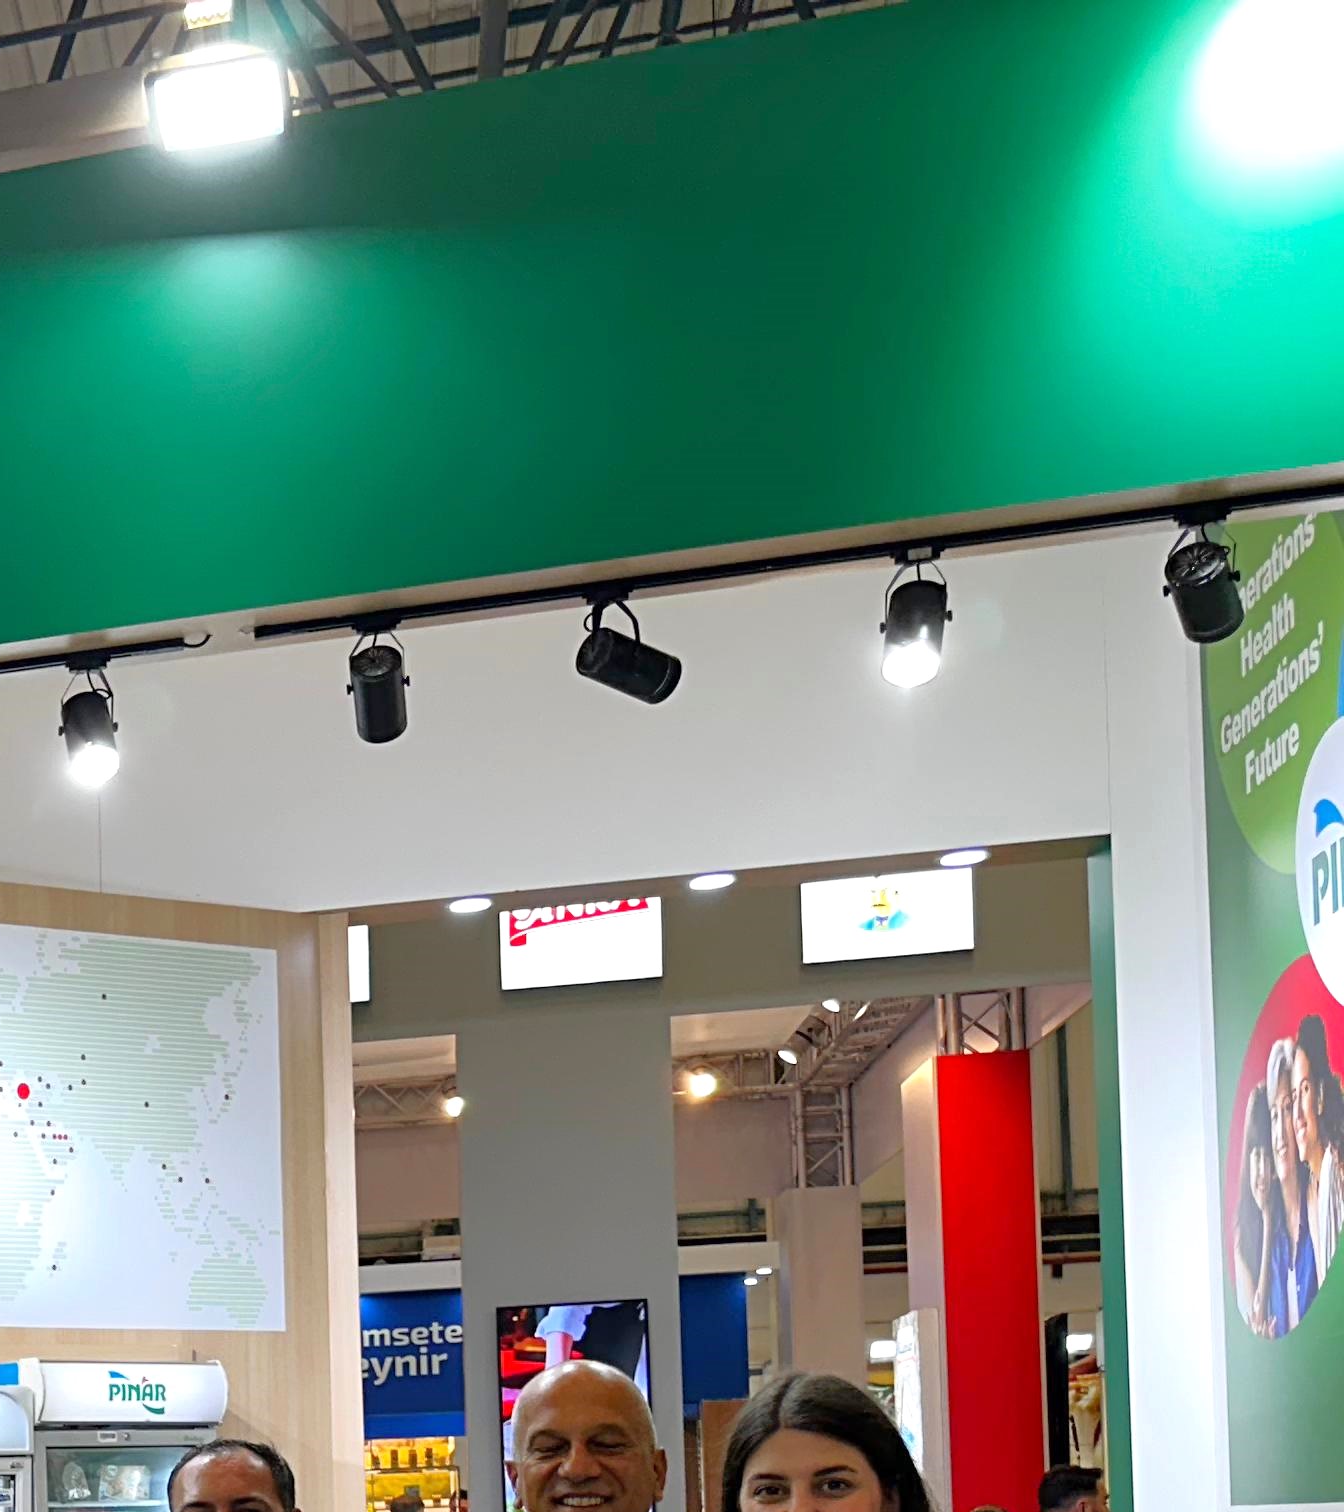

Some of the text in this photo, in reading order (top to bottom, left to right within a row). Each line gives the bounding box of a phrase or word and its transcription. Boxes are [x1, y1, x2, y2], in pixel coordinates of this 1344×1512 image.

[1240, 511, 1317, 614] nerations'
[1240, 592, 1295, 678] Health
[1221, 620, 1324, 753] Generations'
[1245, 722, 1300, 795] Future
